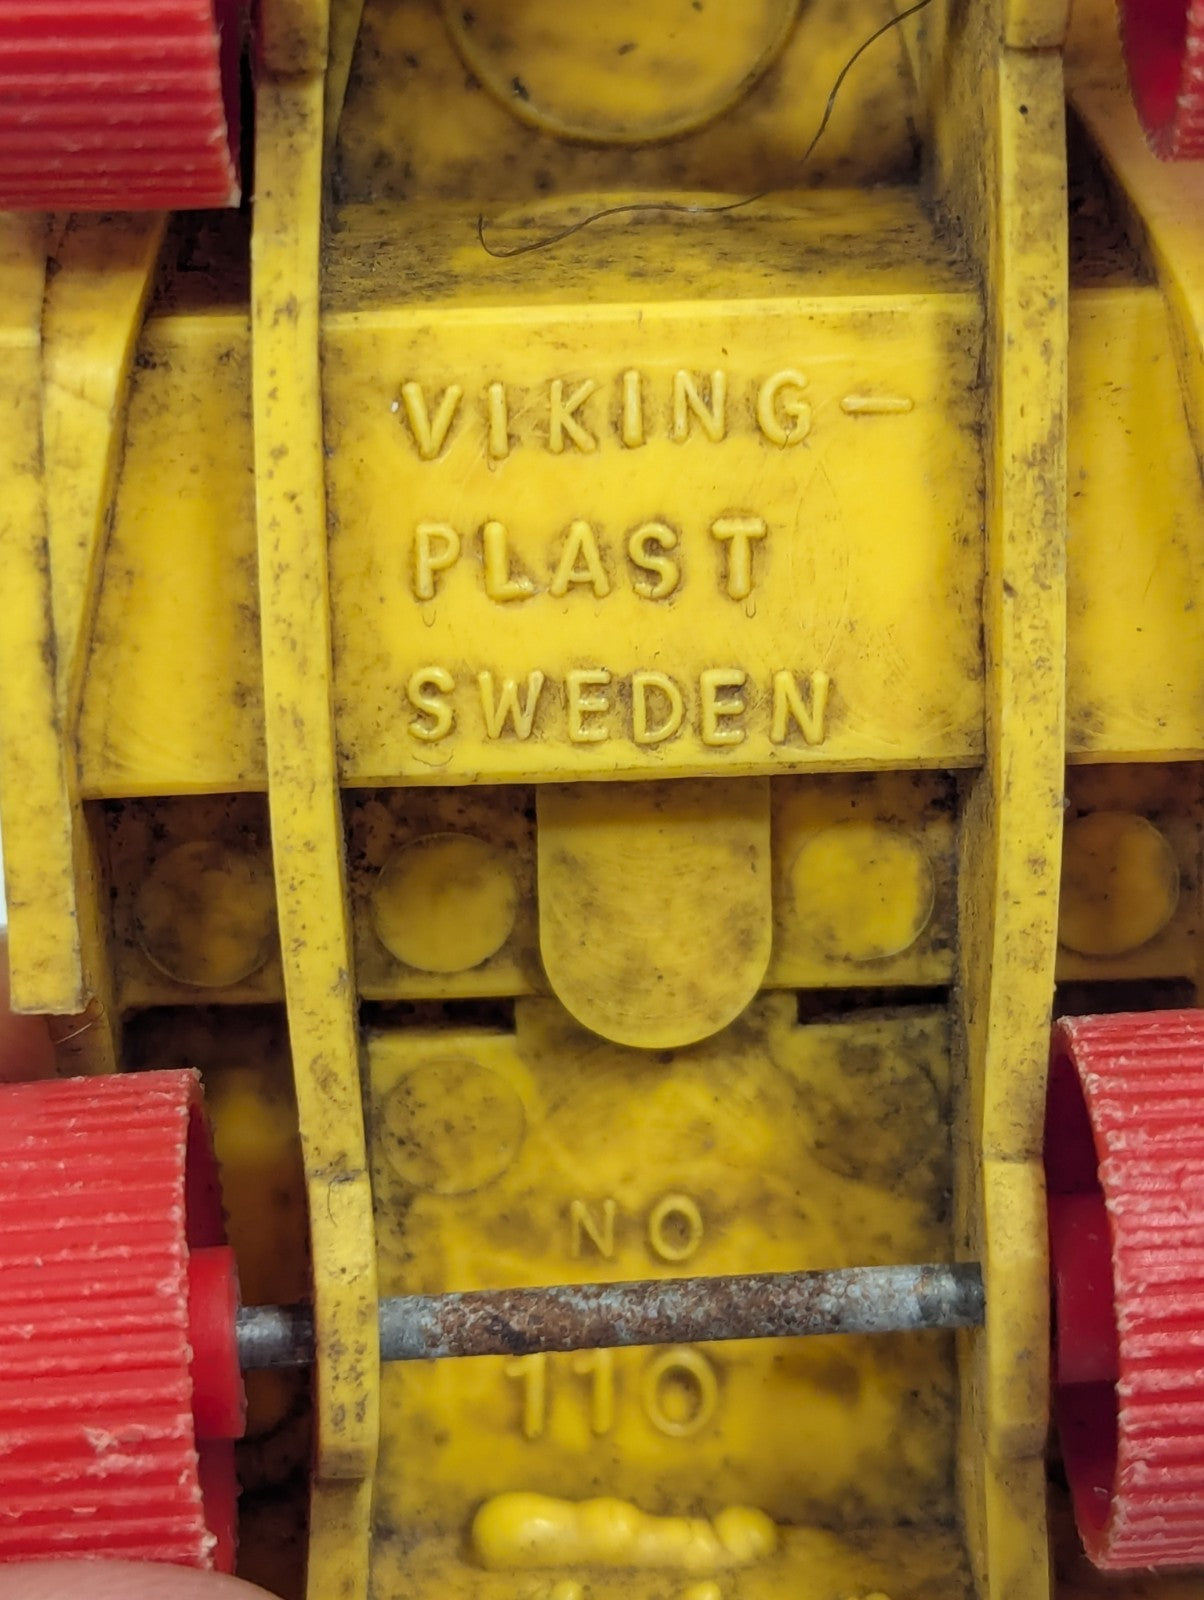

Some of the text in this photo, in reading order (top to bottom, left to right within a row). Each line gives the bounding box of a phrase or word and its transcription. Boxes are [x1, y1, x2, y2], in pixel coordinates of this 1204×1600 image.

[410, 518, 769, 604] PLAST
[404, 666, 834, 747] SWEDEN
[568, 1193, 705, 1263] NO
[503, 1346, 721, 1438] 110
